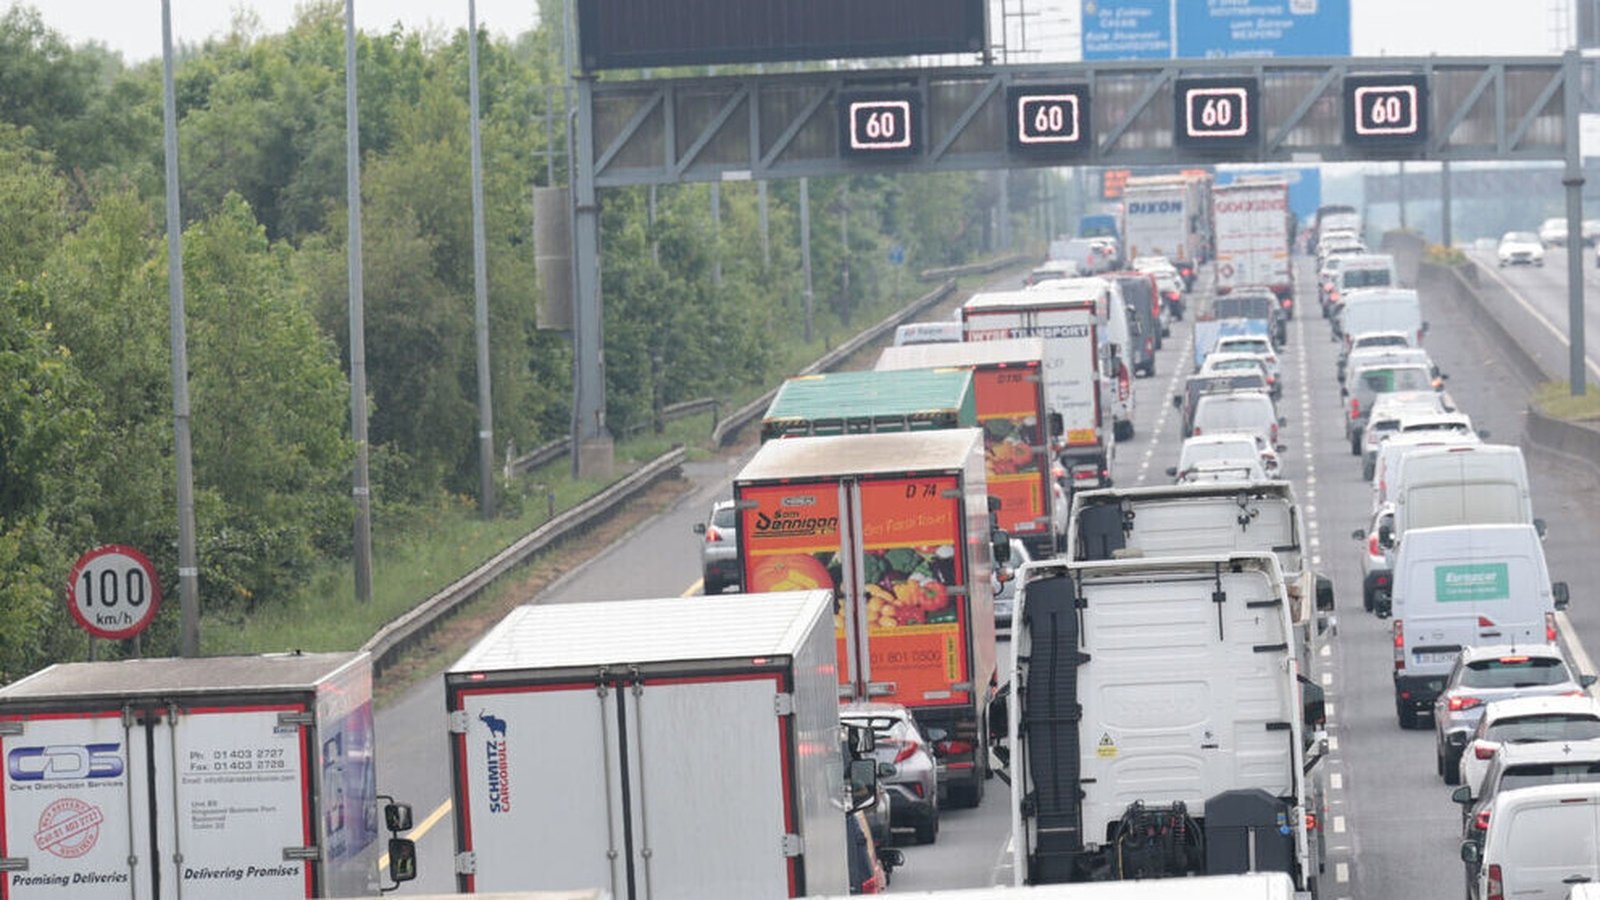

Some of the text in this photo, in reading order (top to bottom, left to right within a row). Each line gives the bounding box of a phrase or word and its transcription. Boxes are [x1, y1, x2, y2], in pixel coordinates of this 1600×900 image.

[1034, 106, 1062, 132] 60
[1202, 100, 1230, 126] 60
[1372, 96, 1400, 123] 60
[866, 111, 894, 138] 60
[1128, 201, 1182, 214] DIXON
[906, 483, 937, 498] D 74
[756, 512, 838, 533] Dennigan
[774, 510, 800, 518] Sam
[82, 568, 145, 608] 100
[96, 612, 133, 626] km/h
[8, 743, 124, 782] CDS
[487, 741, 500, 813] SCHMITZ
[498, 740, 510, 812] CARGOBULL
[12, 872, 128, 886] Promising Deliveries
[184, 866, 300, 880] Delivering Promises
